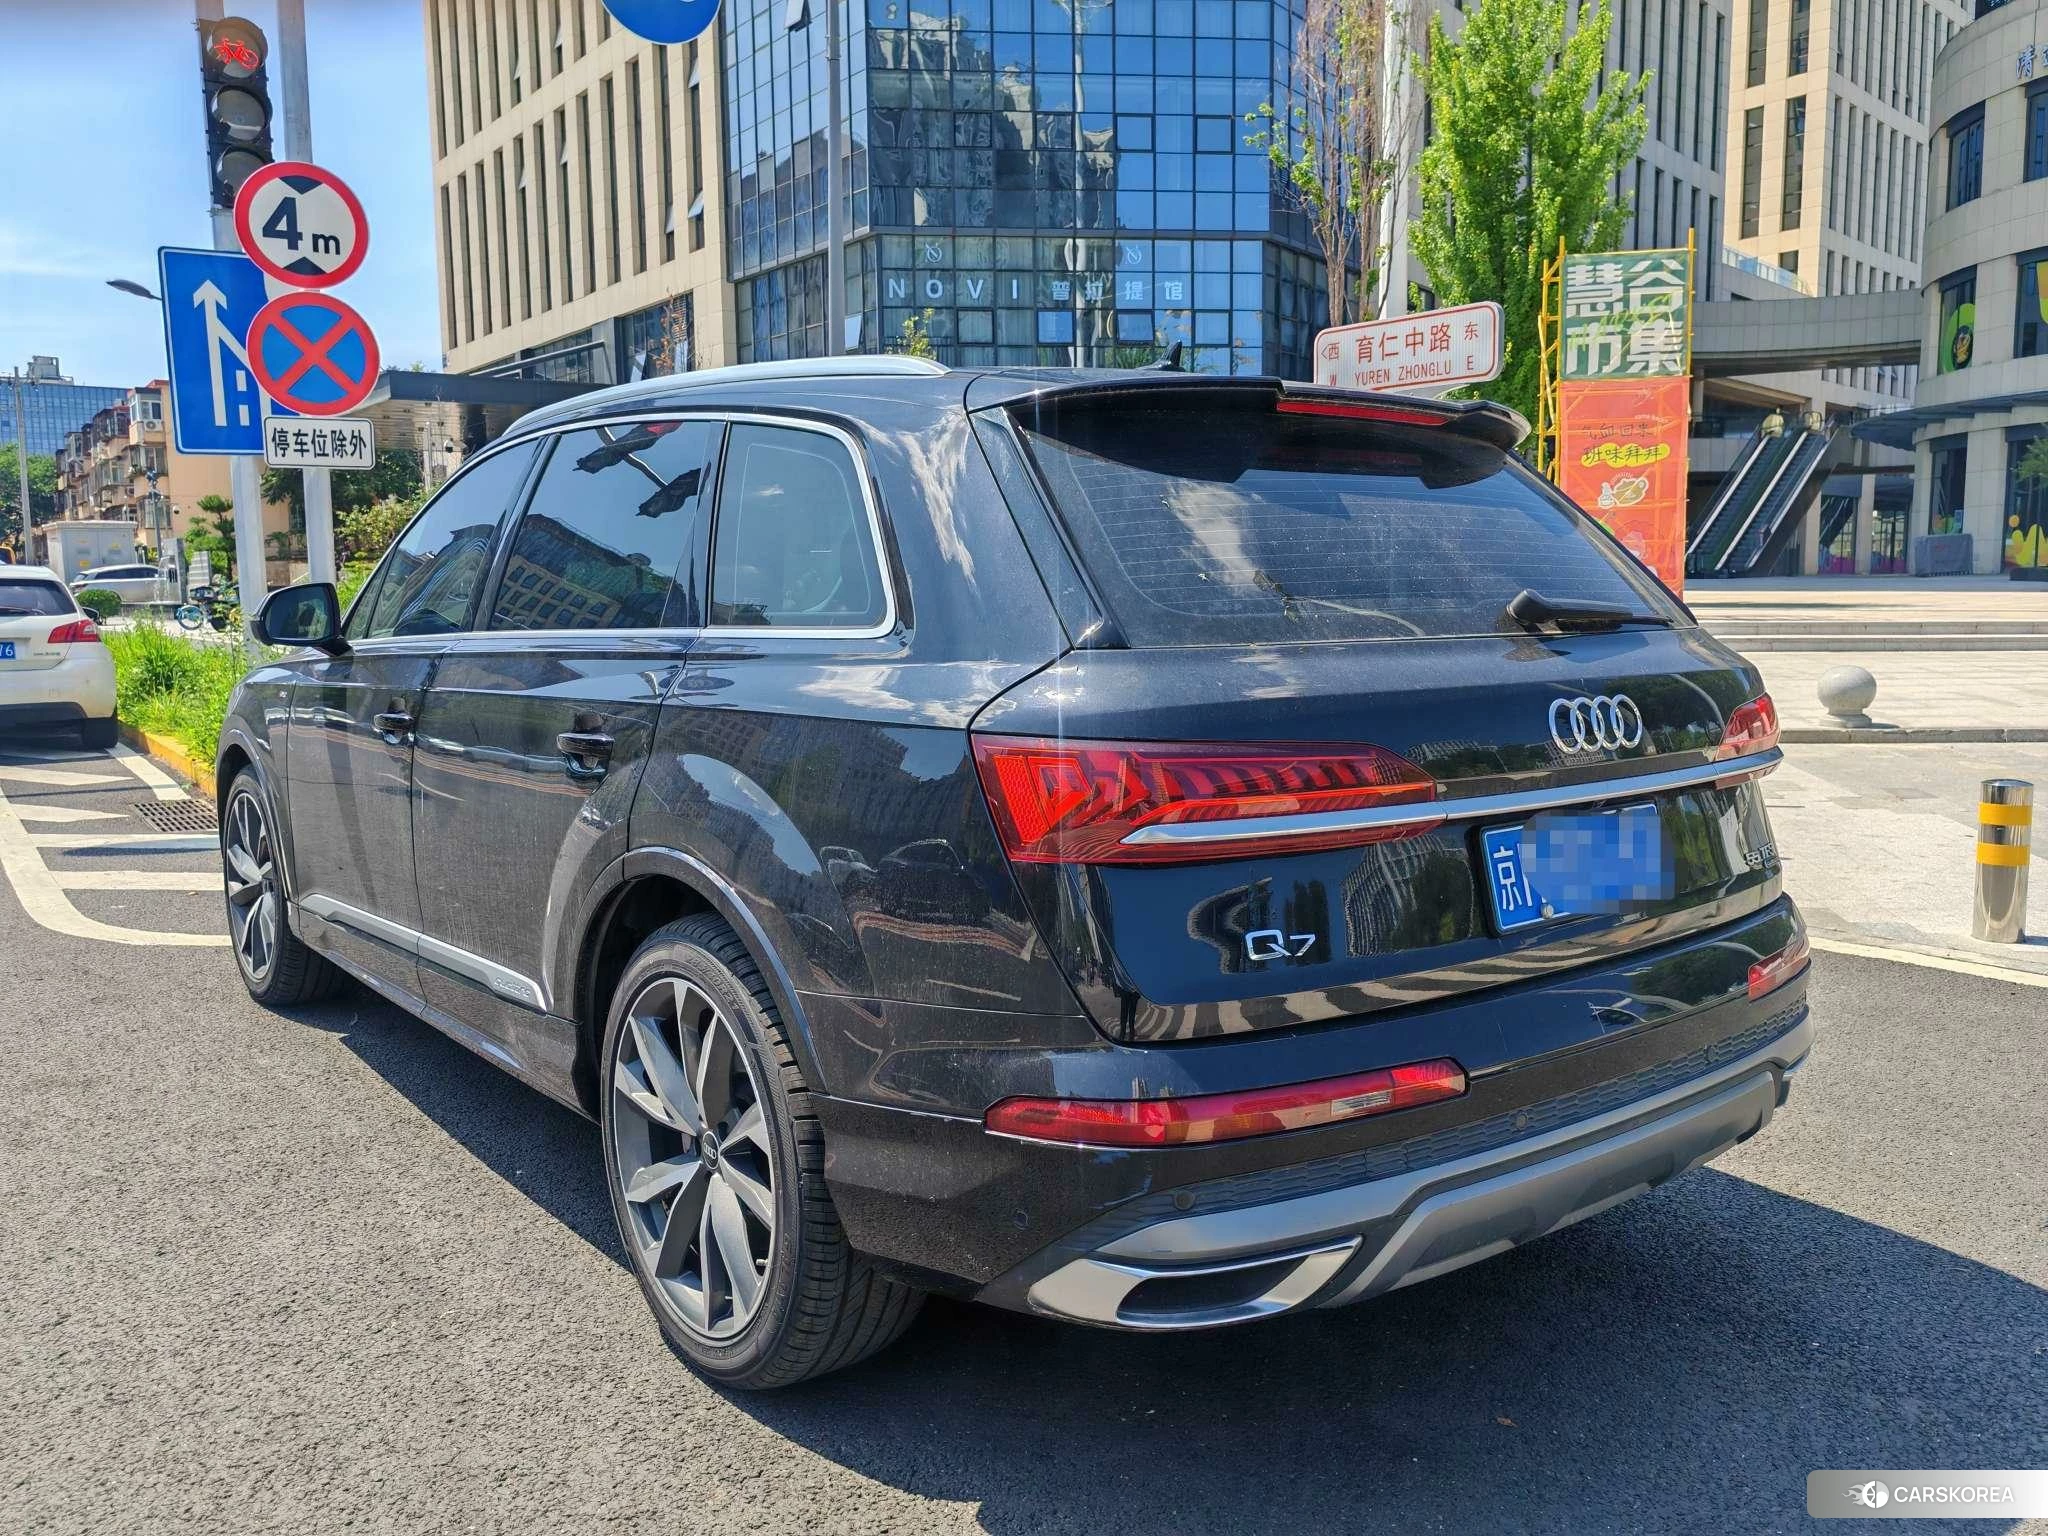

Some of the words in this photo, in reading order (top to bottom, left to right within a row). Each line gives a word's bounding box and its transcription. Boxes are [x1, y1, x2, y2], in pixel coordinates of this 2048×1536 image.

[262, 196, 303, 251] 4
[312, 233, 340, 255] m
[888, 278, 1019, 301] NOVI
[1051, 280, 1184, 302] 普拉提馆
[1566, 259, 1686, 319] 慧谷
[1328, 341, 1341, 360] 西
[1355, 322, 1452, 365] 育仁中路
[1463, 321, 1480, 341] 东
[1566, 319, 1685, 376] 市集
[1354, 368, 1391, 386] YUREN
[1398, 359, 1452, 381] ZHONGLU
[1466, 355, 1475, 371] E
[271, 427, 367, 460] 停车位除外
[1245, 929, 1316, 961] Q7
